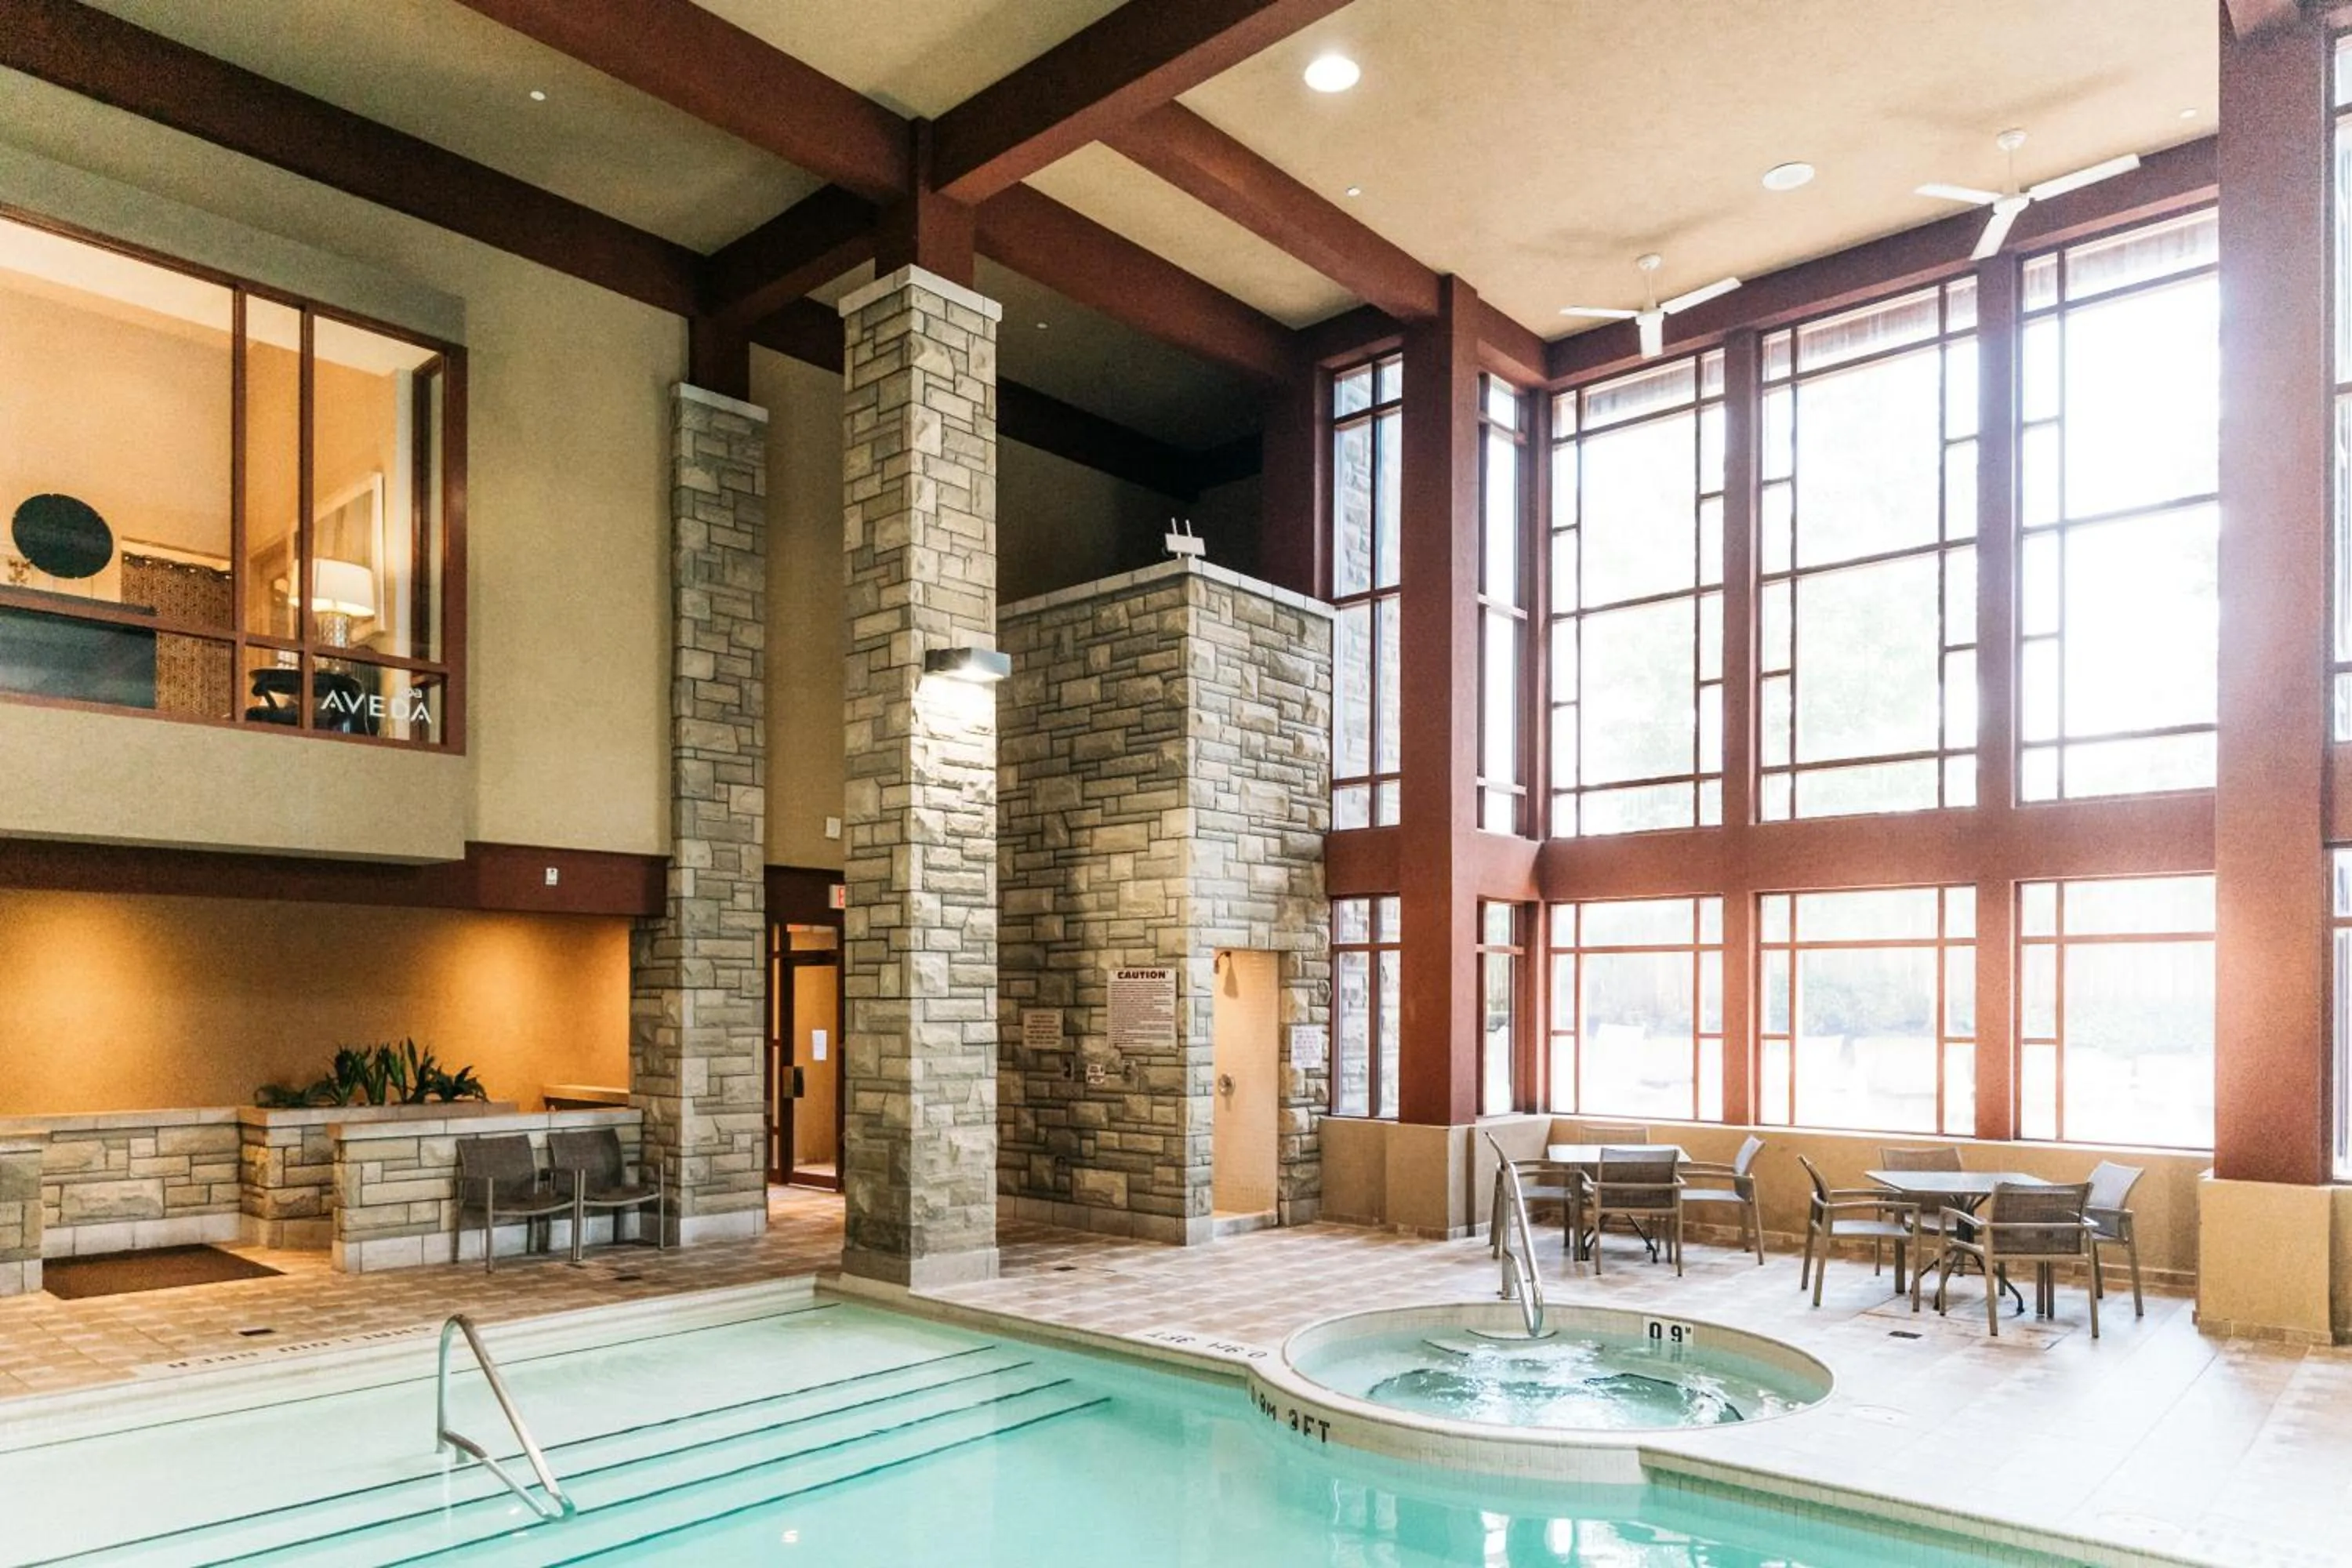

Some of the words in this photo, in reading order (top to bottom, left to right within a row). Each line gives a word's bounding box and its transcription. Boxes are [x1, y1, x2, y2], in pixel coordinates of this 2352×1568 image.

[321, 690, 432, 724] AVEDA
[1117, 971, 1166, 979] CAUTION
[1288, 1409, 1330, 1443] 3FT
